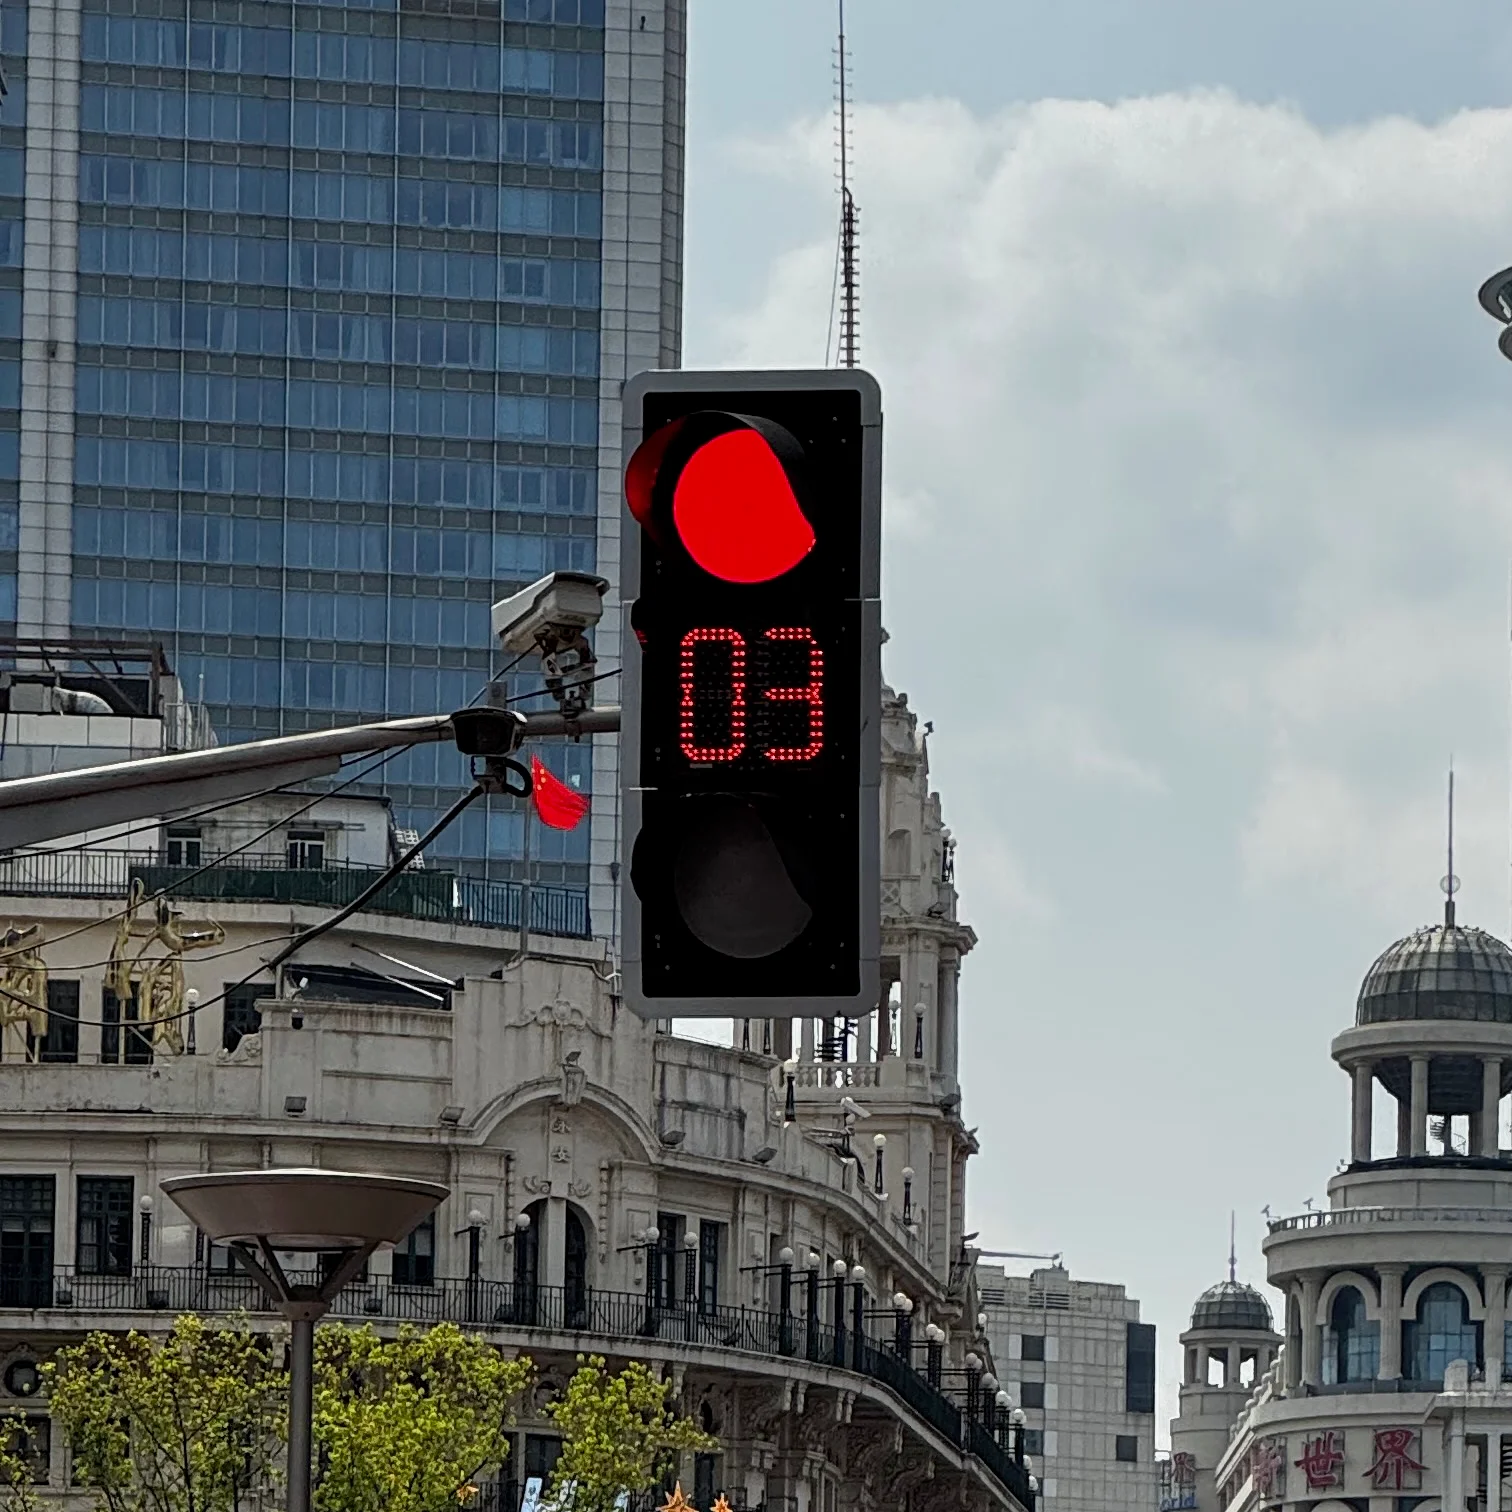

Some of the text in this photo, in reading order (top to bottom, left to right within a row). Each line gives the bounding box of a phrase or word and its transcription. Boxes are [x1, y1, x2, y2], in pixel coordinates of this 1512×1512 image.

[680, 627, 824, 761] 03
[1249, 1428, 1431, 1498] 新世界
